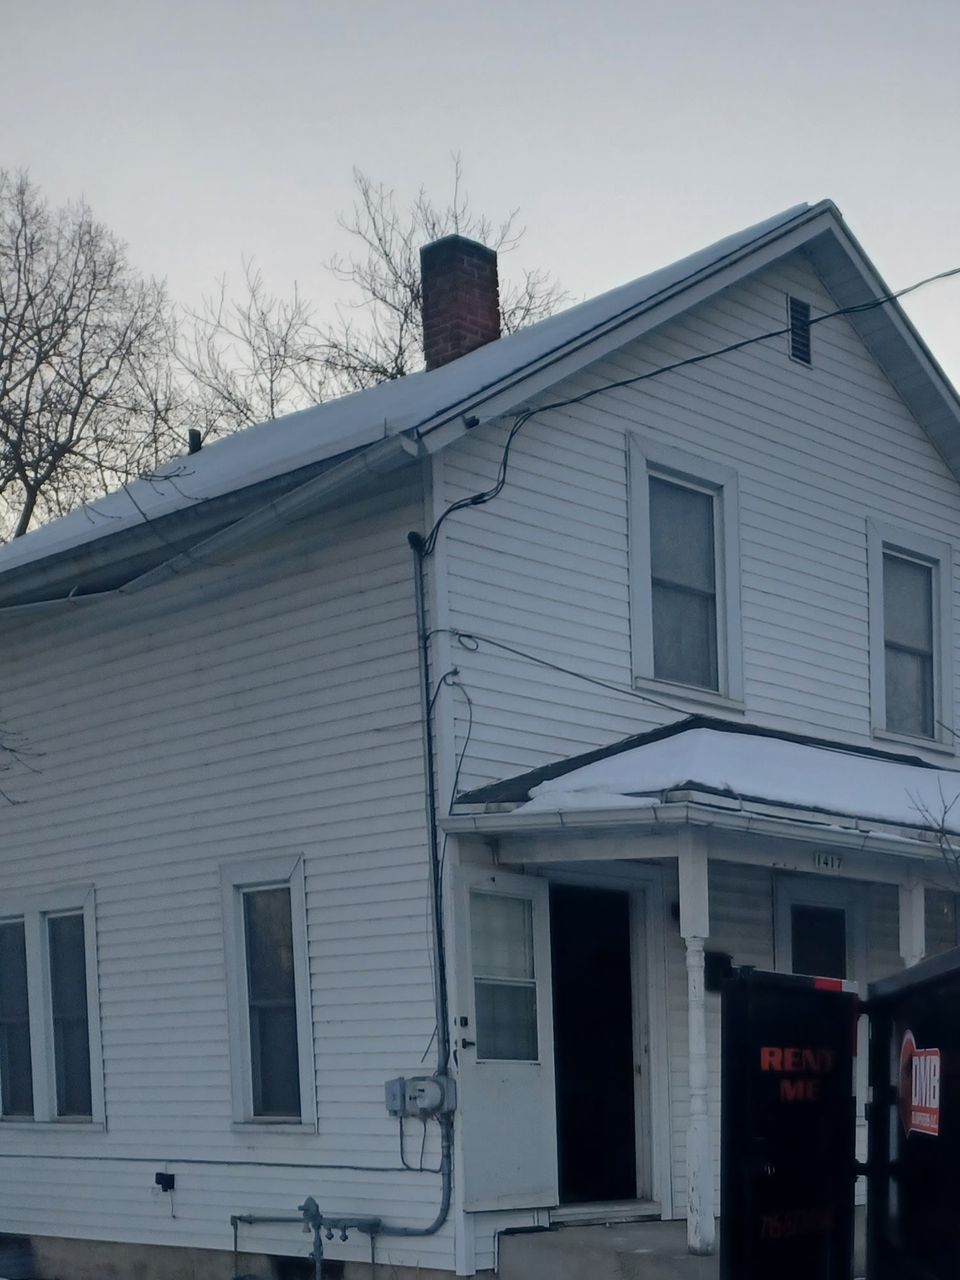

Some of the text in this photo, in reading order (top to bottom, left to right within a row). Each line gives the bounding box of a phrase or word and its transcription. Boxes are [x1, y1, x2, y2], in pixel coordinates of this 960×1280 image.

[760, 1046, 835, 1072] RENT
[779, 1077, 821, 1102] ME
[911, 1056, 940, 1108] DMB
